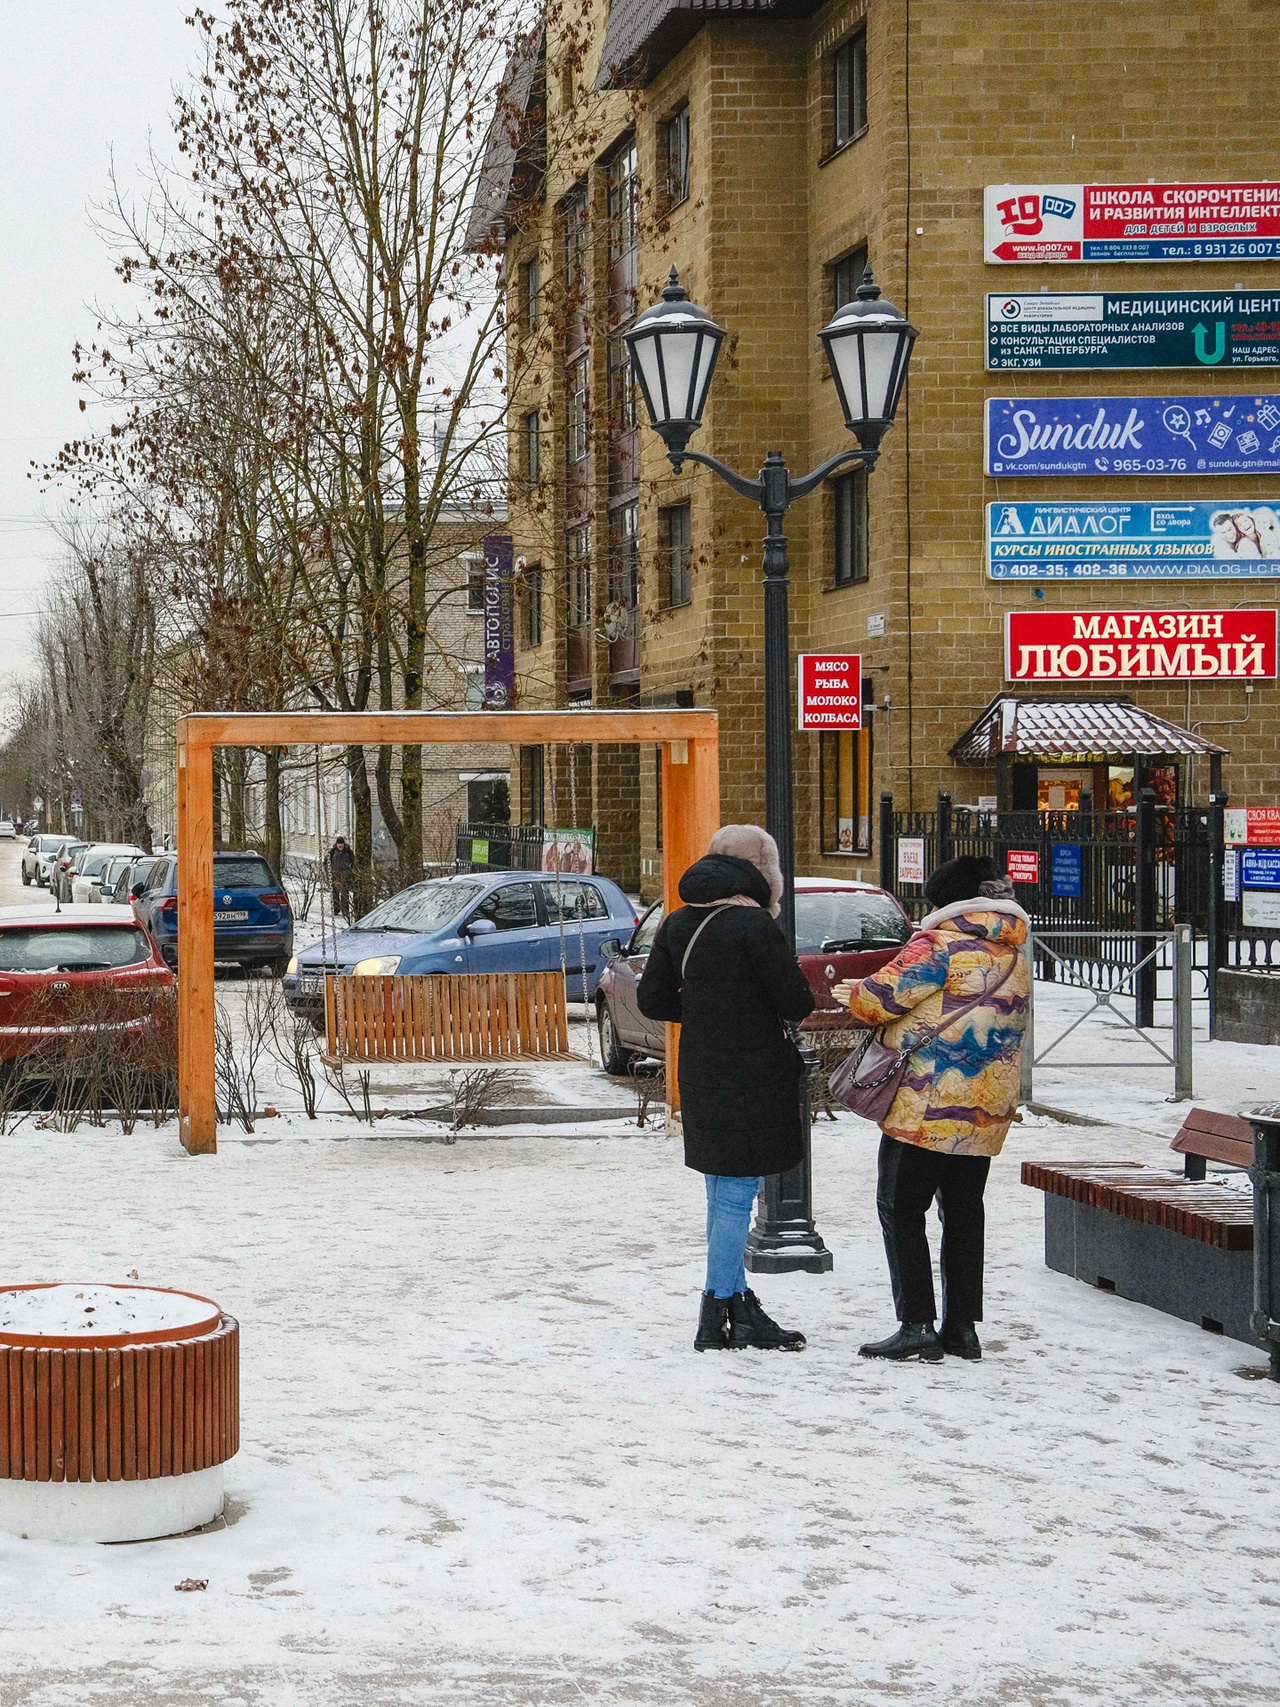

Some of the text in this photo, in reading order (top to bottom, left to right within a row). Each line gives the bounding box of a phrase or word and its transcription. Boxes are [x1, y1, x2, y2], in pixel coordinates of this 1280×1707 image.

[1089, 188, 1280, 205] ШКОЛА СКОРОЧТЕНИ
[1045, 199, 1074, 215] 007
[1090, 208, 1101, 220] И
[1104, 207, 1185, 220] РАЗВИТИЯ
[1124, 221, 1257, 235] ДЛЯ ДЕТЕЙ И ВЗРОСЛЫХ
[1012, 243, 1073, 252] www.iq007.ru
[1162, 247, 1191, 255] тел.:
[1194, 245, 1202, 254] 8
[1205, 244, 1227, 254] 931
[1229, 244, 1245, 254] 26
[1248, 244, 1273, 254] 007
[1108, 297, 1234, 317] МЕДИЦИНСКИЙ
[1000, 322, 1185, 334] ВСЕ ВИДЫ ЛАБОРАТОРНЫХ АНАЛИЗОВ
[1000, 335, 1156, 347] КОНСУЛЬТАЦИИ СПЕЦИАЛИСТОВ
[1013, 346, 1108, 355] САНКТ-ПЕТЕРБУРГА
[1252, 346, 1280, 354] АДРЕС:
[1001, 358, 1041, 367] ЭКГ, УЗИ
[1232, 355, 1279, 364] ул. Горького,
[997, 408, 1145, 459] Sunduk
[1005, 462, 1087, 472] vk.com/sundukgtn
[1113, 459, 1187, 471] 965-03-76
[1029, 515, 1131, 534] ДИАЛОГ
[995, 543, 1214, 556] КУРСЫ ИНОСТРАННЫХ ЯЗЫКОВ
[1010, 564, 1127, 577] 402-35; 402-36
[1072, 615, 1224, 639] МАГАЗИН
[1016, 634, 1266, 677] ЛЮБИМЫЙ
[815, 662, 849, 671] МЯСО
[815, 679, 849, 689] РЫБА
[806, 696, 857, 706] МОЛОКО
[804, 713, 859, 723] КОЛБАСА
[1247, 810, 1266, 821] СВОЯ
